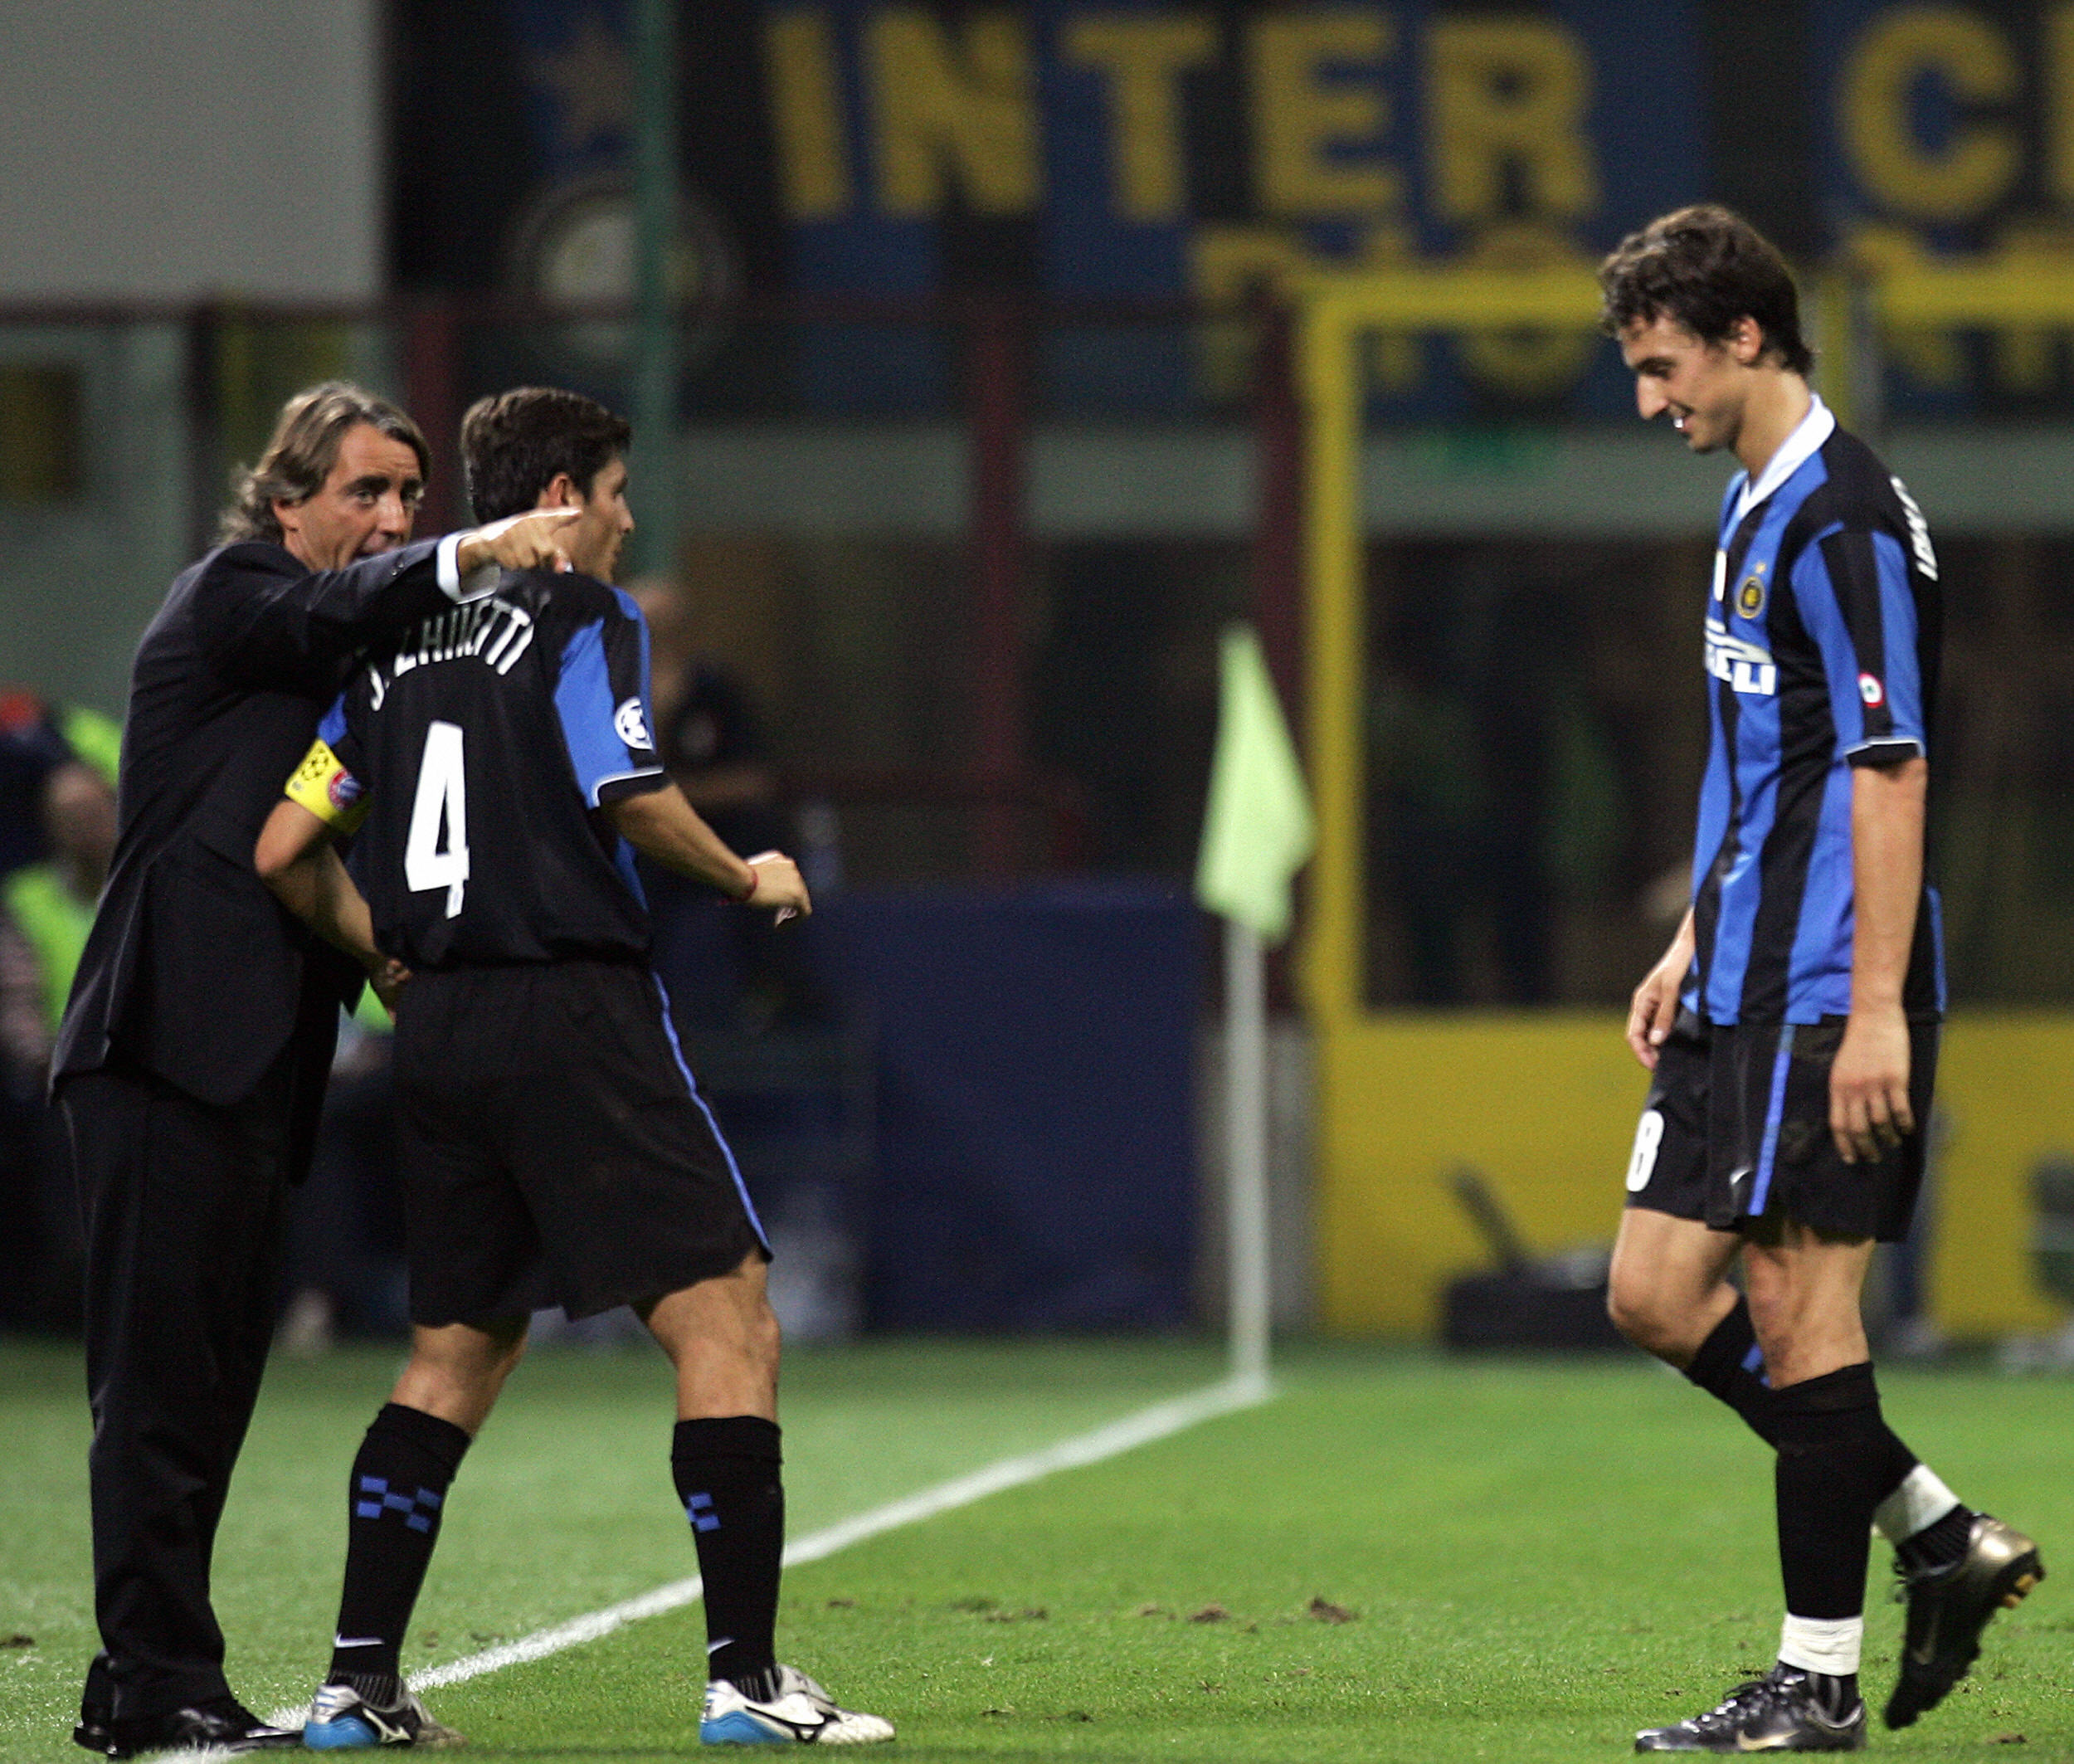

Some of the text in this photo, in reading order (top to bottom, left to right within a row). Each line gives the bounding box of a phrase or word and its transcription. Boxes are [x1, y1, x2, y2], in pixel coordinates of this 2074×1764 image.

[765, 10, 1599, 222] INTER
[405, 721, 470, 919] 4
[1626, 1109, 1664, 1192] 8
